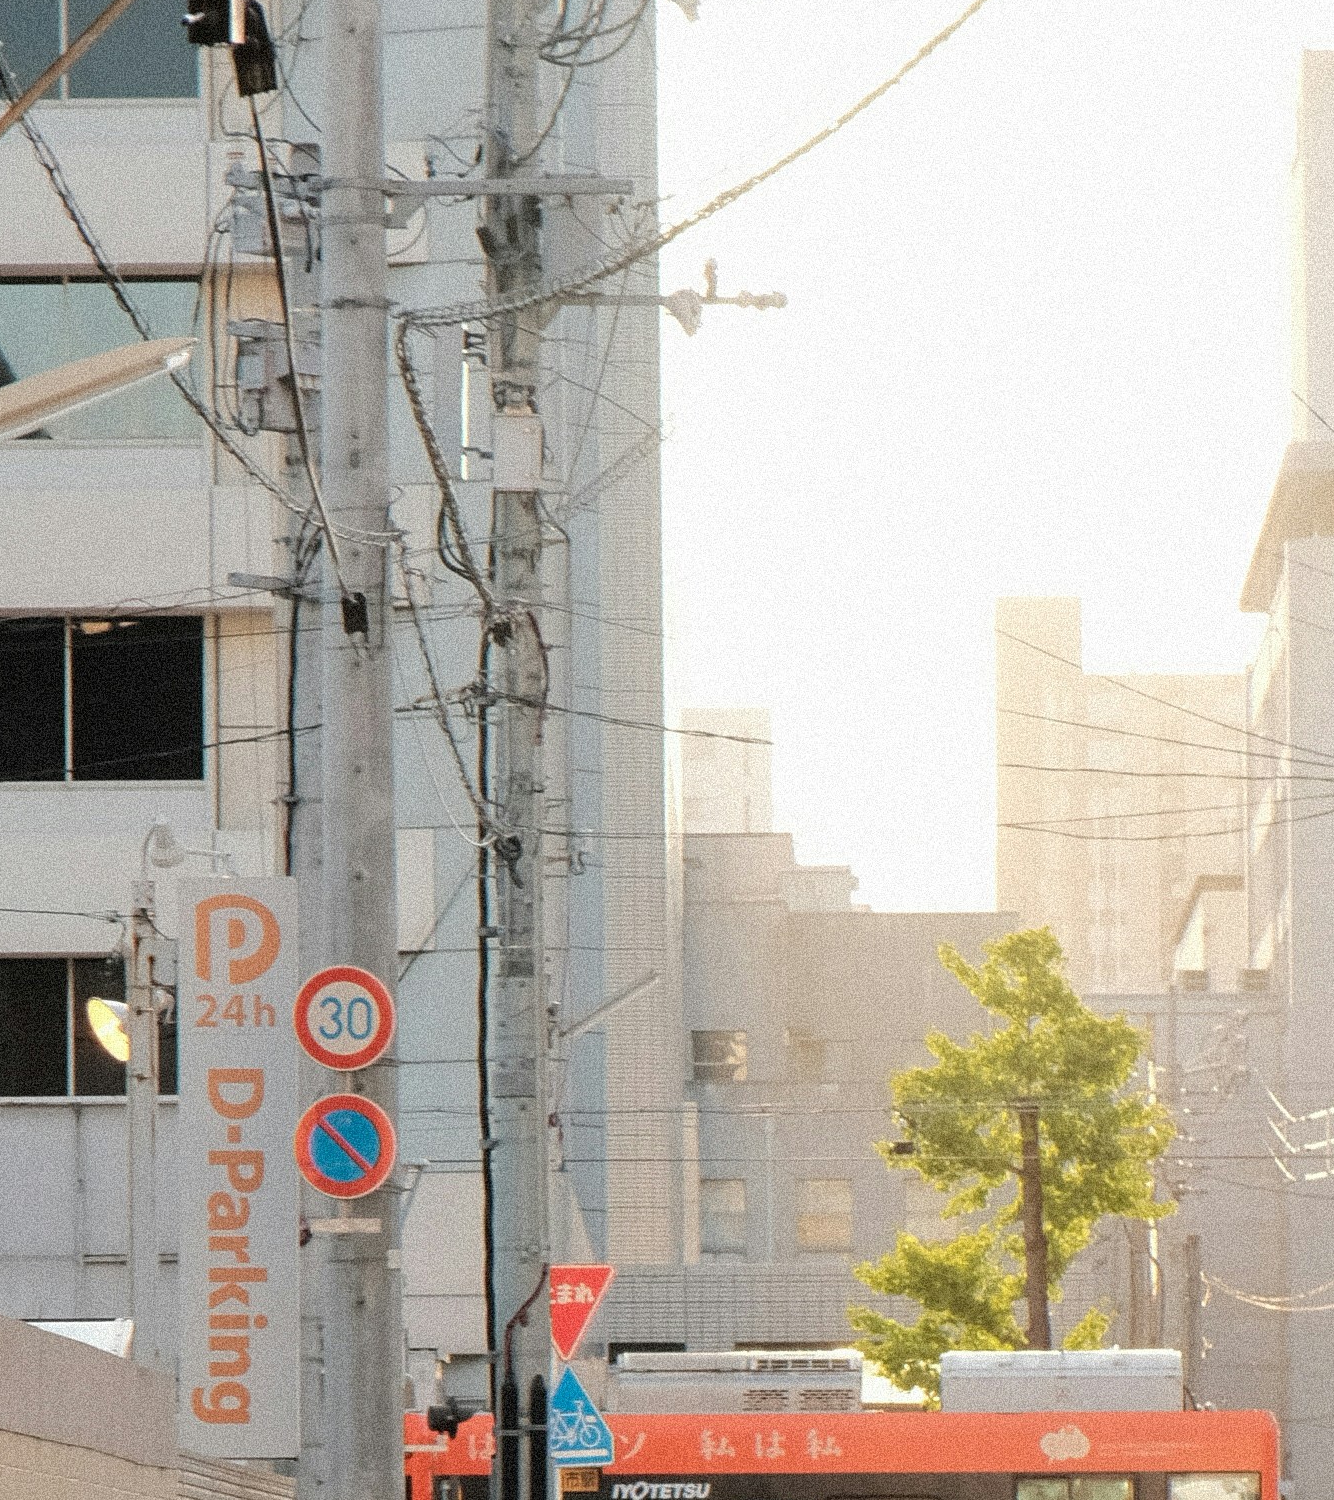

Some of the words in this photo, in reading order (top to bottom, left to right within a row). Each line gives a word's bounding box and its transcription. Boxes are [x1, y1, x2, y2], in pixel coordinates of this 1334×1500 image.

[195, 995, 277, 1028] 24h
[318, 996, 373, 1040] 30
[191, 1067, 268, 1425] D-Parking
[550, 1282, 595, 1305] まれ
[611, 1481, 711, 1500] IYOTETSU
